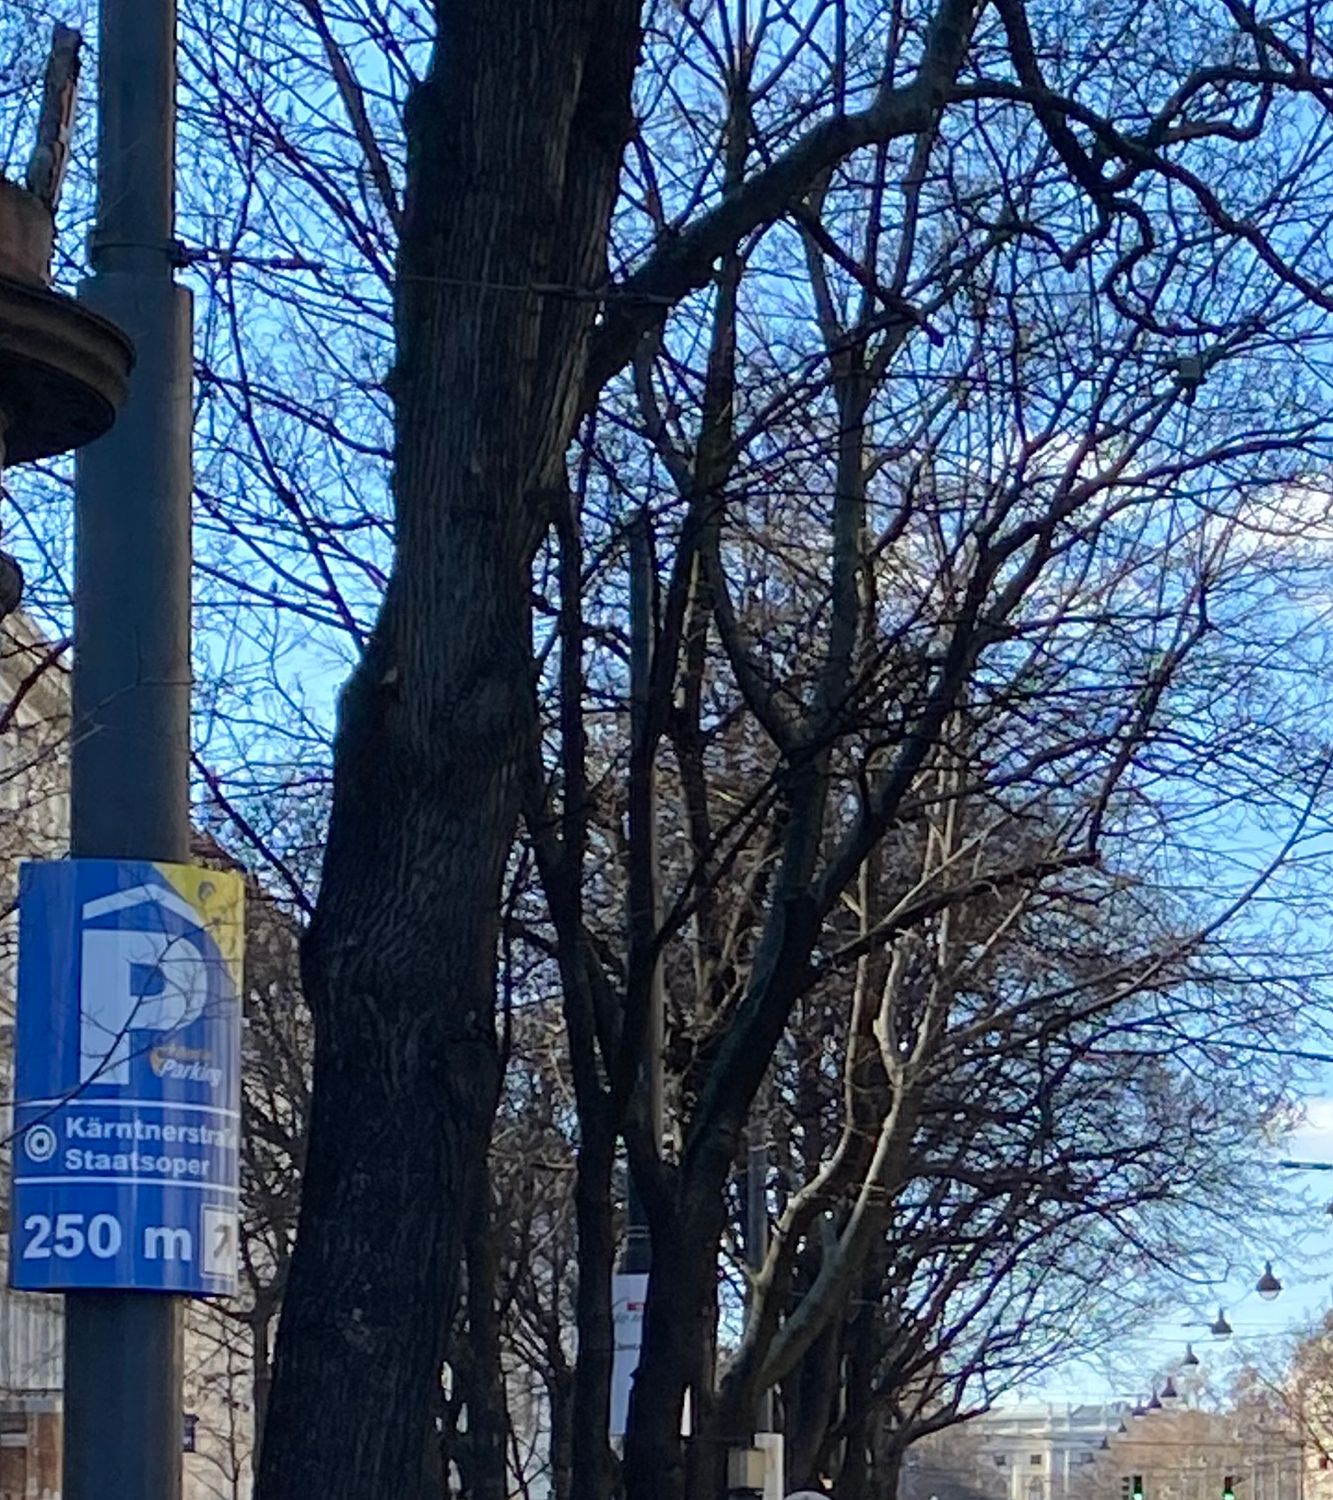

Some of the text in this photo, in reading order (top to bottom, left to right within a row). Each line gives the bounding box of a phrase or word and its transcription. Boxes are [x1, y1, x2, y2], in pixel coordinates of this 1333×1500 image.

[160, 1059, 223, 1087] Parking
[65, 1149, 210, 1177] Staatsoper
[23, 1213, 192, 1261] 250 m
